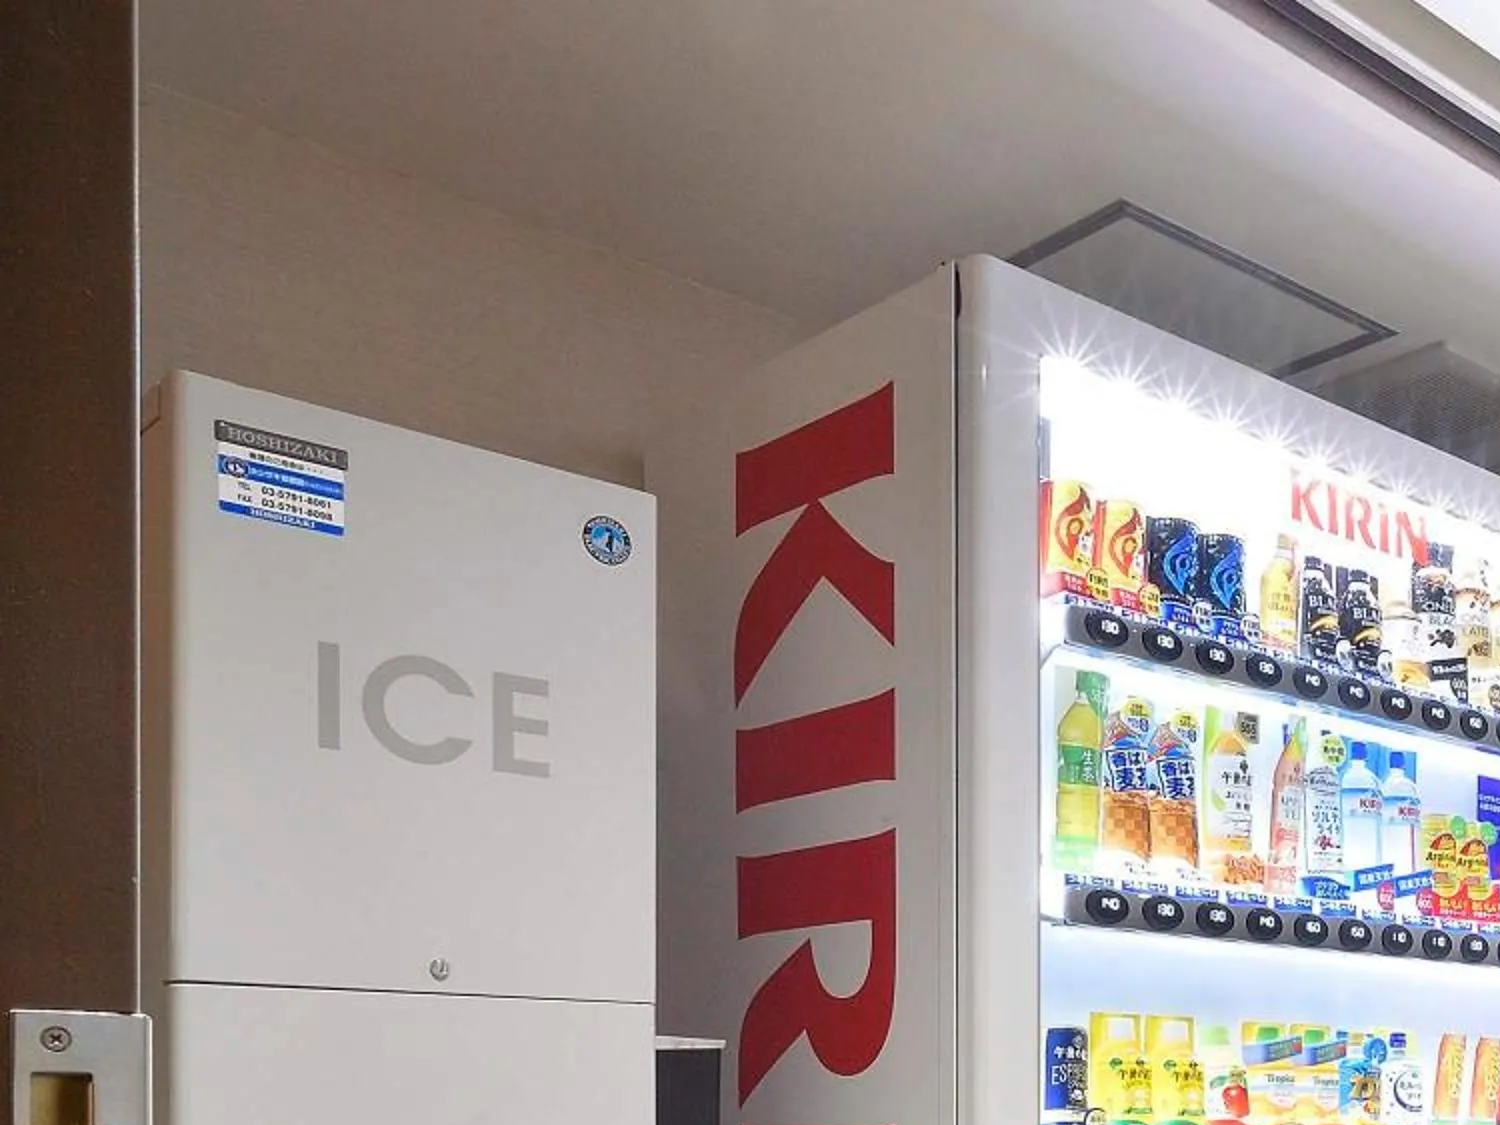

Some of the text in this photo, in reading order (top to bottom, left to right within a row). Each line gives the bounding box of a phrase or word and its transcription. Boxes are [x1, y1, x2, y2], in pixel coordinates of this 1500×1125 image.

[228, 427, 337, 462] HOSHIZAKI
[1291, 480, 1429, 567] KIRIN
[317, 640, 551, 779] ICE
